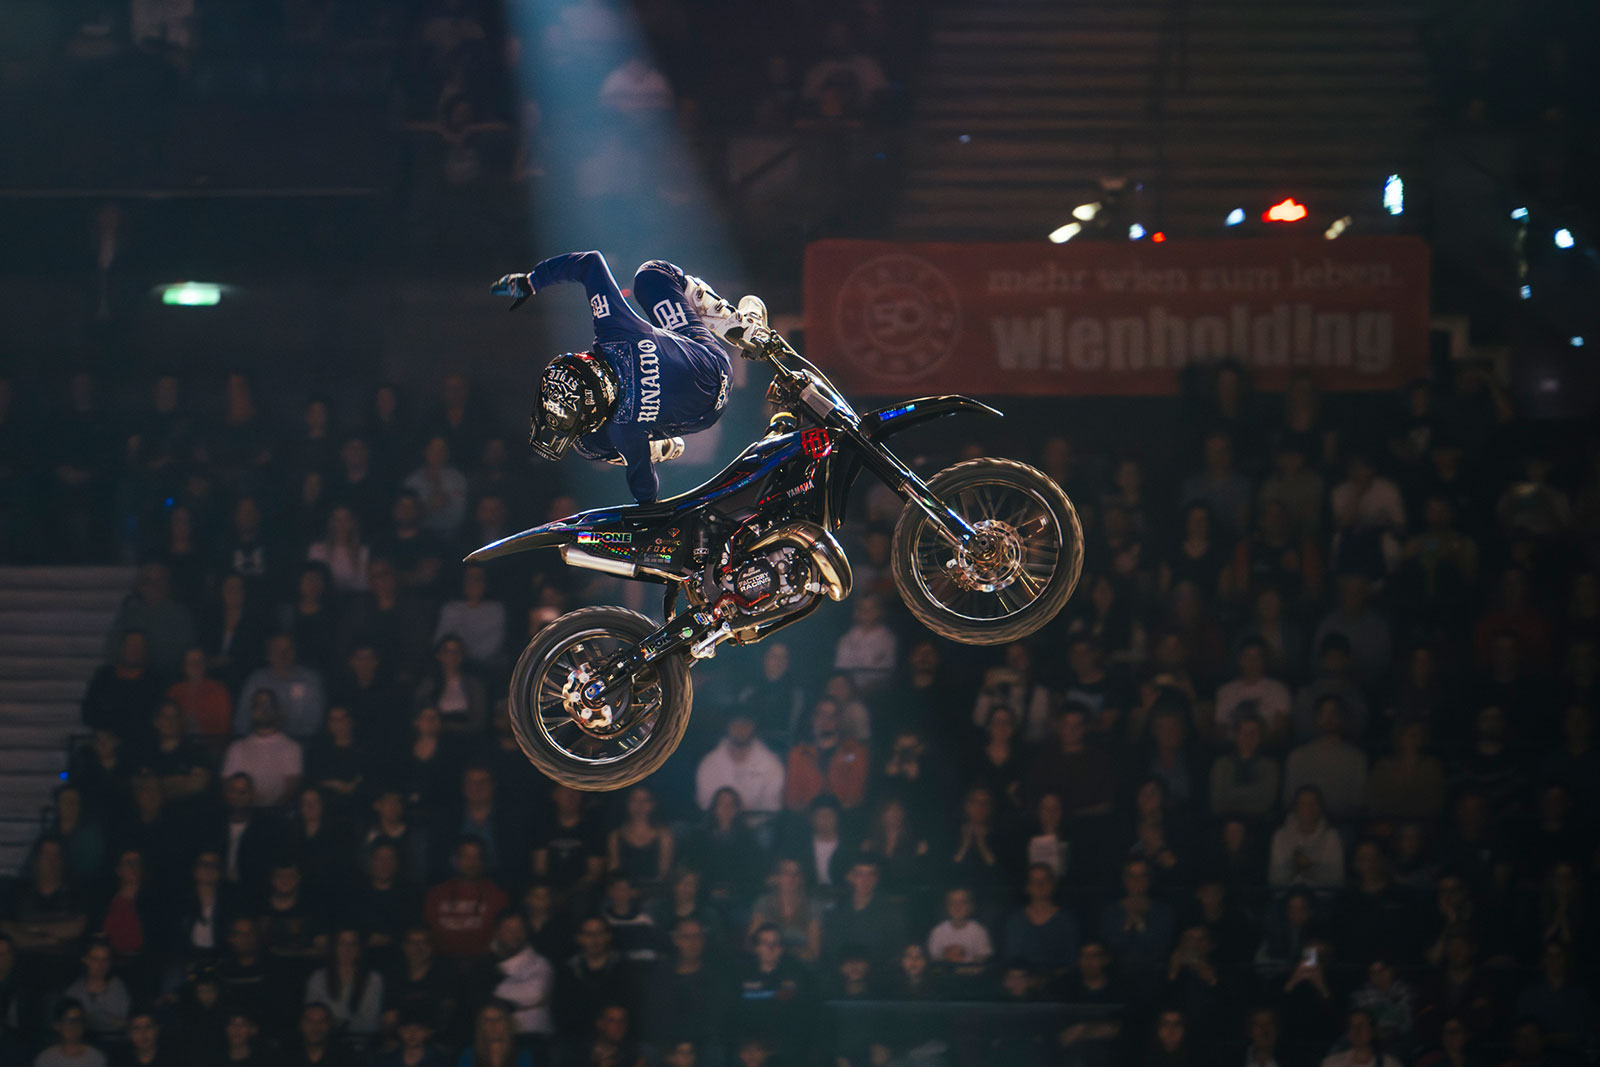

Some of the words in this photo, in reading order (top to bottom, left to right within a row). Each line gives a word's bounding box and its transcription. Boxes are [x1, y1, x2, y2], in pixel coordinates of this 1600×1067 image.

[986, 262, 1087, 292] mehr
[637, 339, 662, 424] RINALDO
[786, 480, 815, 498] YAMAHA
[590, 532, 632, 544] IPONE
[738, 572, 769, 587] FACTORY
[740, 577, 771, 592] RACING
